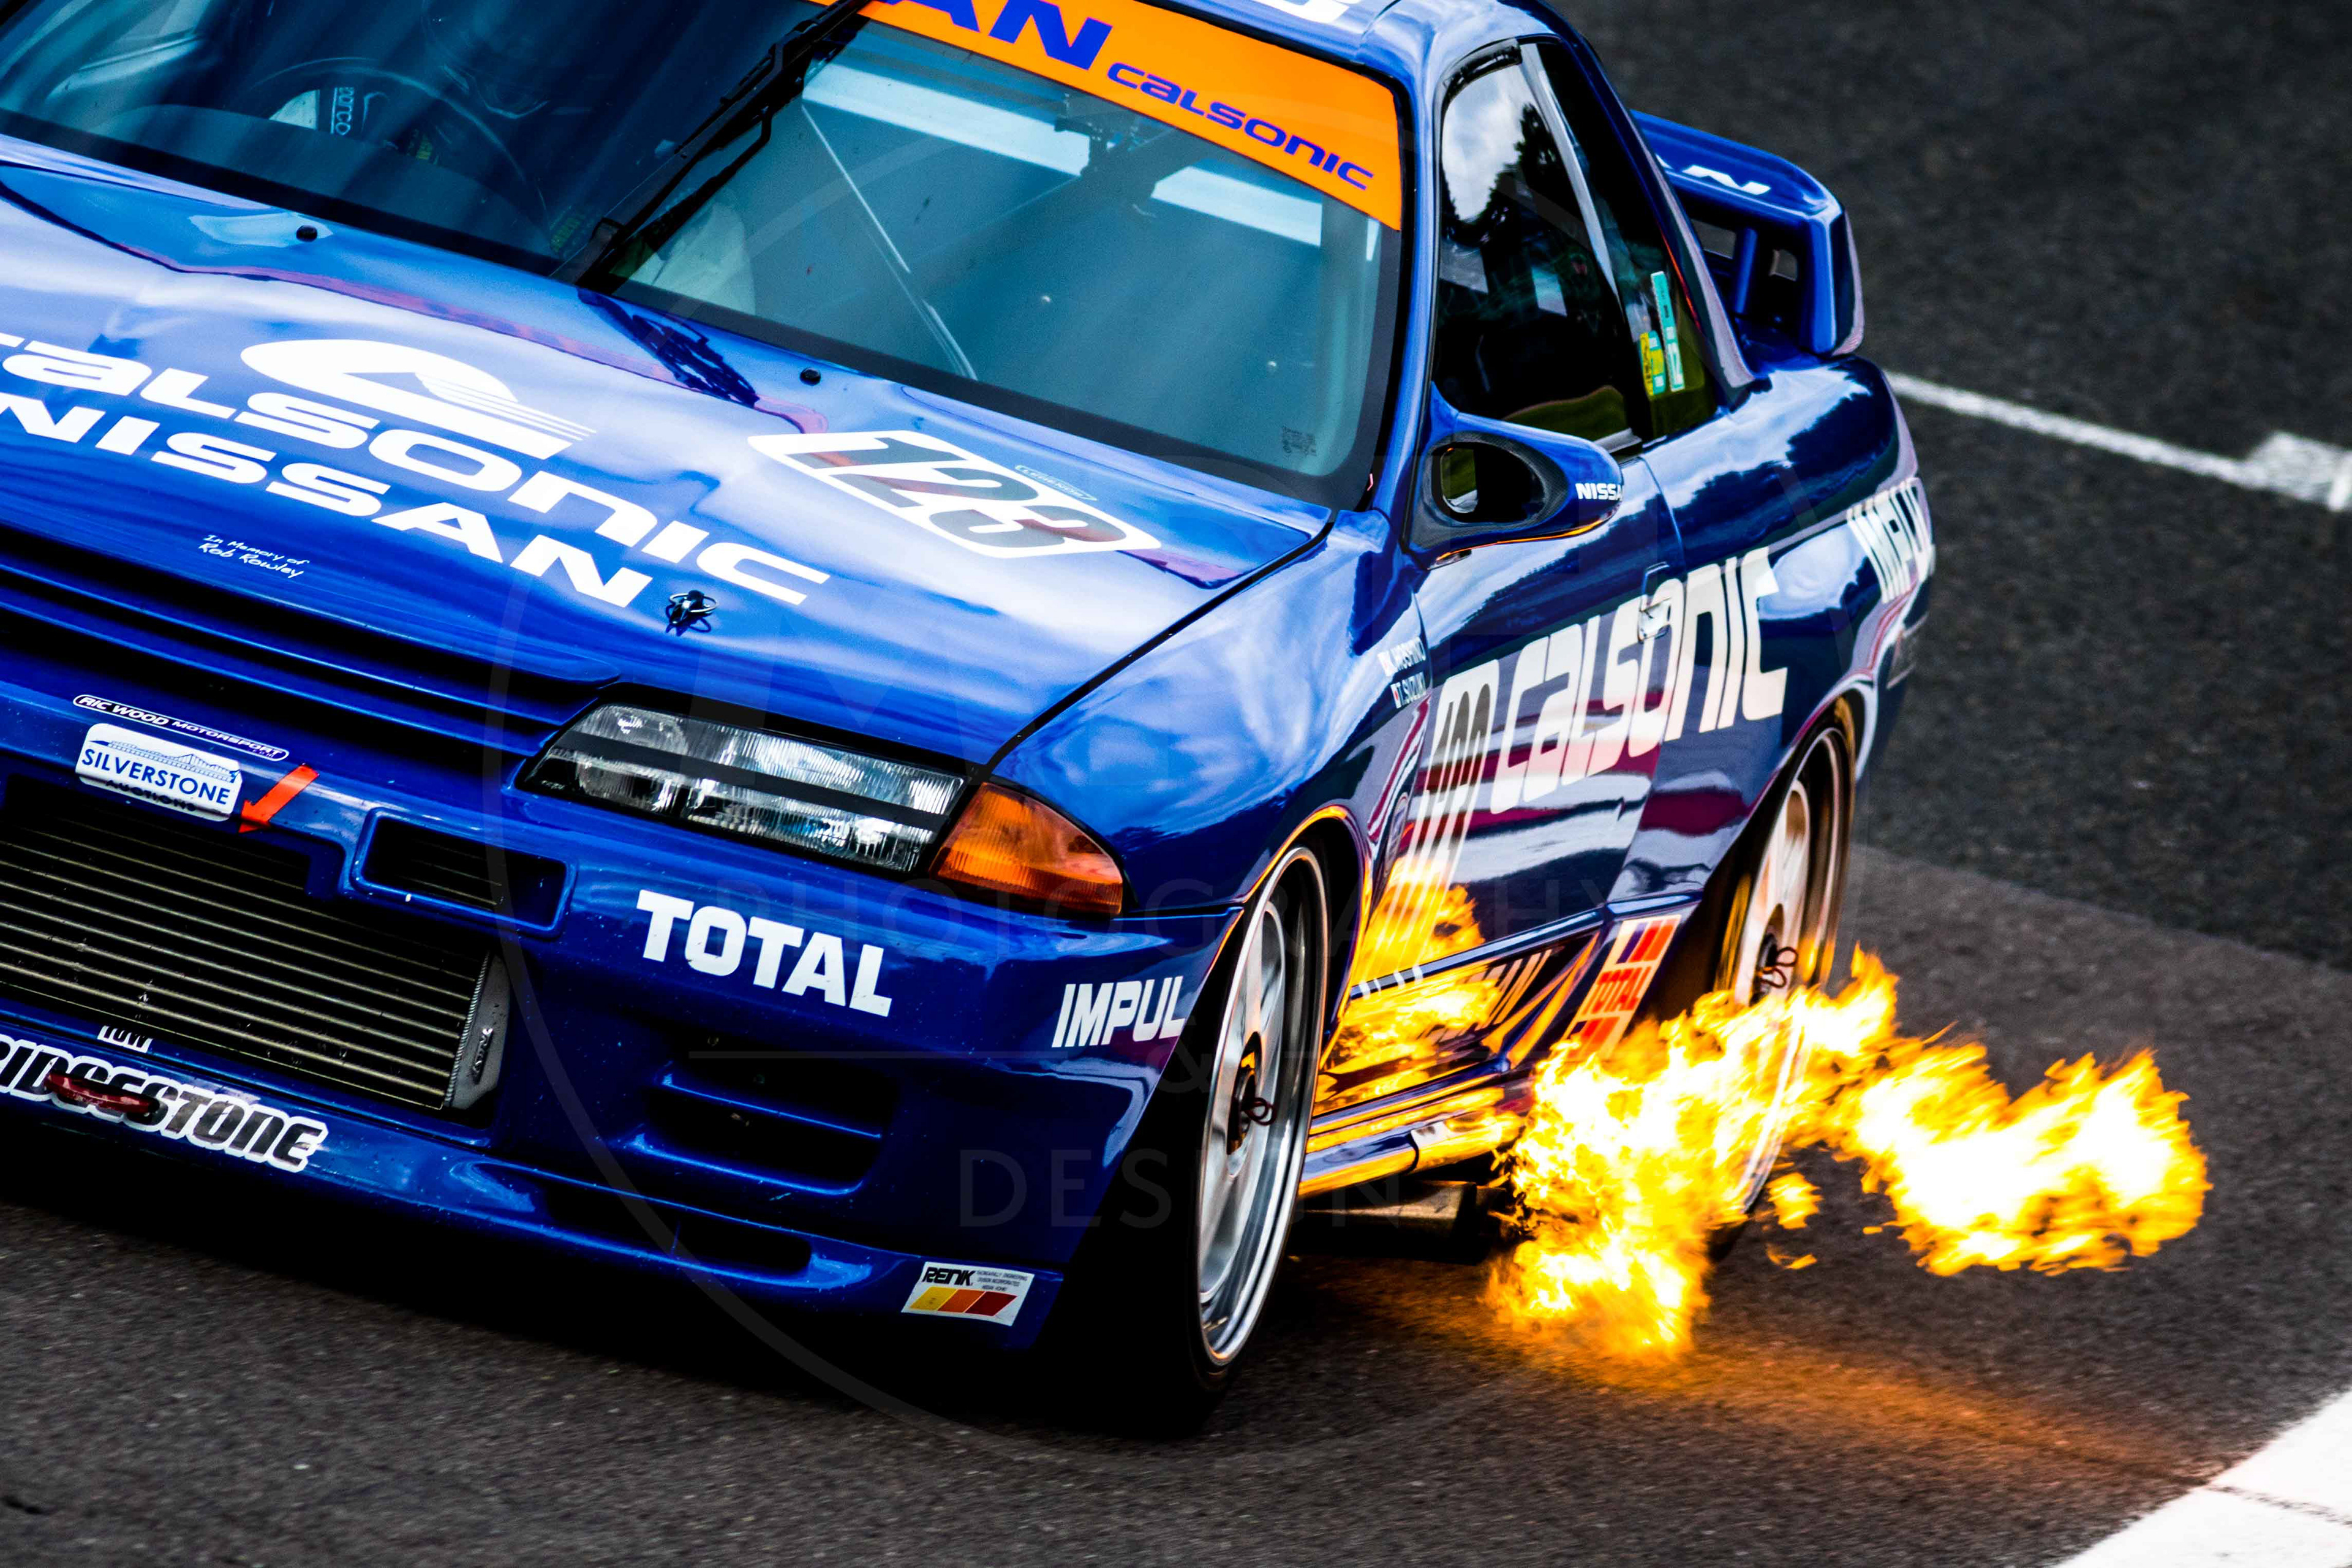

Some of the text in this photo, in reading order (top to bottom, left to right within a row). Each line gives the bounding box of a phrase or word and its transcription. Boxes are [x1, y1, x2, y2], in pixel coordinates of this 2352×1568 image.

[0, 392, 653, 608] NISSAN
[785, 437, 1128, 549] 123
[198, 542, 305, 579] Rob Rowley
[203, 534, 224, 543] In
[227, 540, 285, 561] Memory
[78, 696, 284, 756] RIC WOOD MOTORSPORT
[81, 748, 232, 806] SILVERSTONE
[636, 889, 892, 1017] TOTAL
